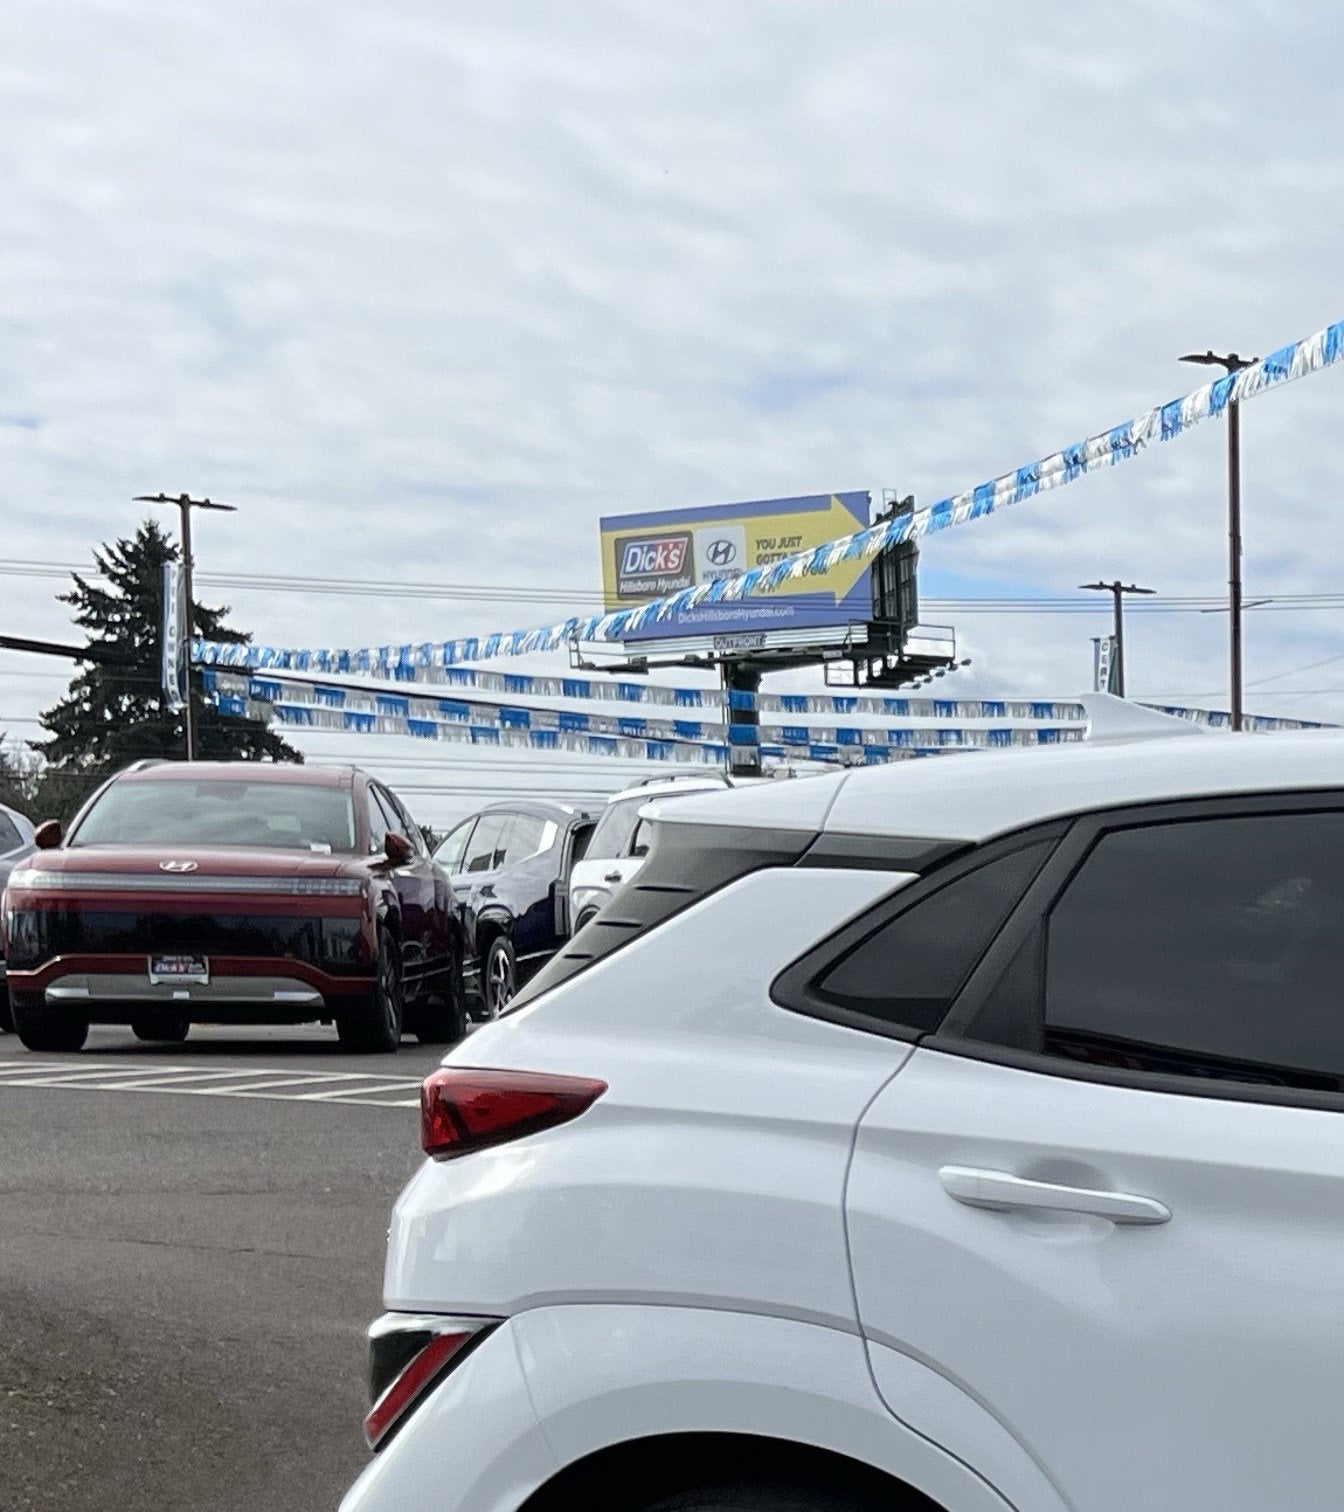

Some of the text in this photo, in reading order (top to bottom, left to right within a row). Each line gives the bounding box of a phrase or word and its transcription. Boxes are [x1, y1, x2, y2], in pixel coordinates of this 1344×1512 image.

[756, 538, 776, 551] YOU
[625, 543, 683, 573] Dick's
[620, 580, 657, 594] Hillsboro
